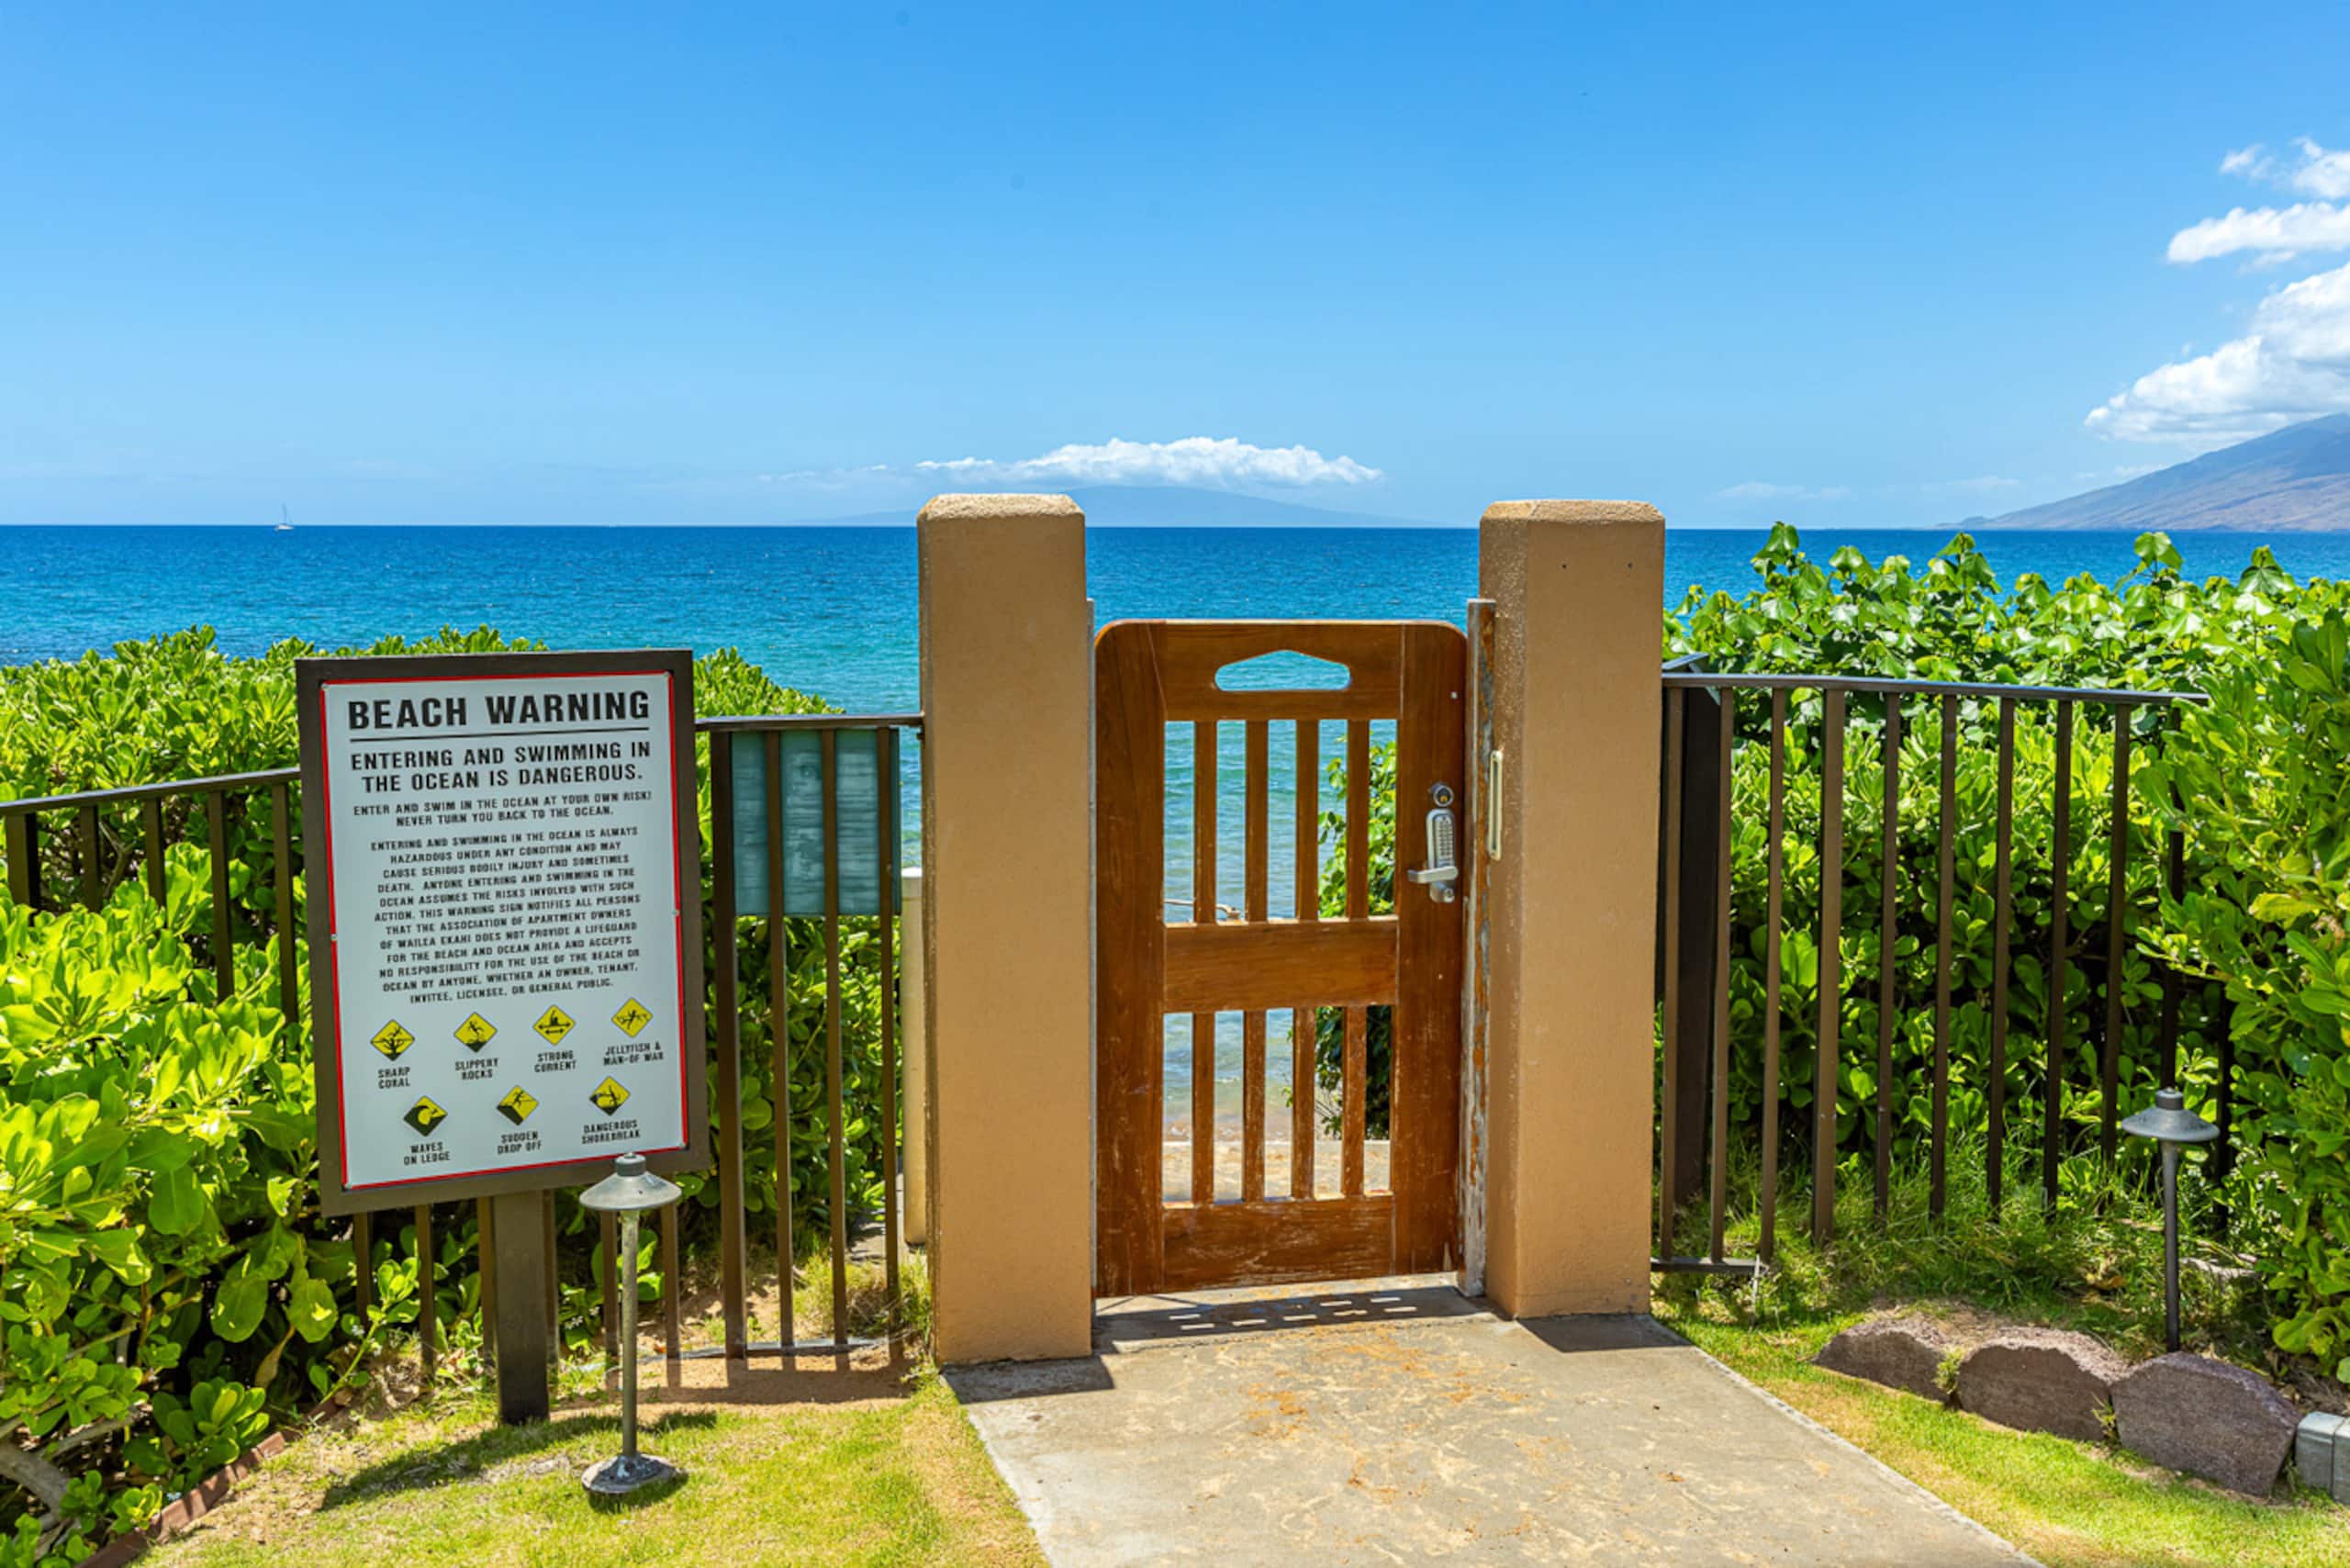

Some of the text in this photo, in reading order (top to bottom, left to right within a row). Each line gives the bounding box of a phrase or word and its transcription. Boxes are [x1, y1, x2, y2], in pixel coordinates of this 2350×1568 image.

[348, 690, 649, 730] BEACH WARNING
[351, 741, 650, 770] ENTERING AND SWIMMING IN
[362, 763, 642, 793] THE OCEAN IS DANGEROUS.
[353, 805, 389, 816] ENTER
[396, 803, 419, 813] AND
[423, 801, 455, 812] SWIM
[460, 801, 472, 810] IN
[476, 799, 498, 809] THE
[502, 797, 538, 808] OCEAN
[543, 796, 556, 806] AT
[562, 794, 589, 805] YOUR
[594, 793, 618, 802] OWN
[397, 815, 432, 827] NEVER
[437, 813, 467, 824] TURN
[472, 812, 493, 823] YOU
[498, 811, 527, 821] BACK
[531, 810, 545, 820] TO
[550, 808, 569, 818] THE
[371, 839, 422, 851] ENTERING
[427, 838, 448, 847] AND
[453, 834, 507, 846] SWIMMING
[511, 834, 521, 842] IN
[526, 833, 543, 842] THE
[549, 830, 581, 840] OCEAN
[599, 827, 638, 837] ALWAYS
[390, 842, 621, 864] HAZARDOUS UNDER ANY CONDITION AND MAY
[383, 855, 629, 879] CAUSE SERIOUS BODILY INJURY AND SOMETIMES
[423, 879, 463, 890] ANYONE
[467, 876, 517, 887] ENTERING
[520, 874, 542, 883] AND
[546, 870, 599, 881] SWIMMING
[603, 869, 613, 878] IN
[617, 868, 634, 877] THE
[380, 881, 634, 907] OCEAN ASSUMES THE RISKS INVOLVED WITH SUCH
[419, 909, 442, 919] THIS
[447, 905, 495, 916] WARNING
[499, 902, 523, 913] SIGN
[527, 900, 571, 911] NOTIFIES
[576, 898, 592, 907] ALL
[596, 894, 641, 906] PERSONS
[386, 909, 631, 935] THAT THE ASSOCIATION OF APARTMENT OWNERS
[380, 940, 392, 949] OF
[475, 932, 501, 943] DOES
[506, 931, 525, 940] NOT
[529, 927, 569, 938] PROVIDE
[574, 926, 581, 935] A
[585, 922, 637, 934] LIFEGUARD
[386, 935, 632, 964] FOR THE BEACH AND OCEAN AREA AND ACCEPTS
[379, 948, 639, 978] NO RESPONSIBILITY FOR THE USE OF THE BEACH OR
[383, 980, 417, 992] OCEAN
[421, 980, 433, 989] BY
[486, 970, 533, 983] WHETHER
[537, 969, 551, 979] AN
[511, 985, 525, 994] OR
[529, 981, 573, 993] GENERAL
[537, 1050, 573, 1062] STRONG
[605, 1043, 650, 1056] JELLYFISH
[643, 1052, 664, 1061] WAR
[377, 1067, 410, 1079] SHARP
[455, 1058, 498, 1071] SLIPPERY
[534, 1060, 576, 1072] CURRENT
[378, 1077, 410, 1089] CORAL
[462, 1069, 493, 1081] ROCKS
[583, 1120, 637, 1134] DANGEROUS
[498, 1140, 542, 1154] DROP OFF
[501, 1131, 538, 1144] SUDDEN
[403, 1151, 450, 1165] ON LEDGE
[410, 1142, 443, 1154] WAVES
